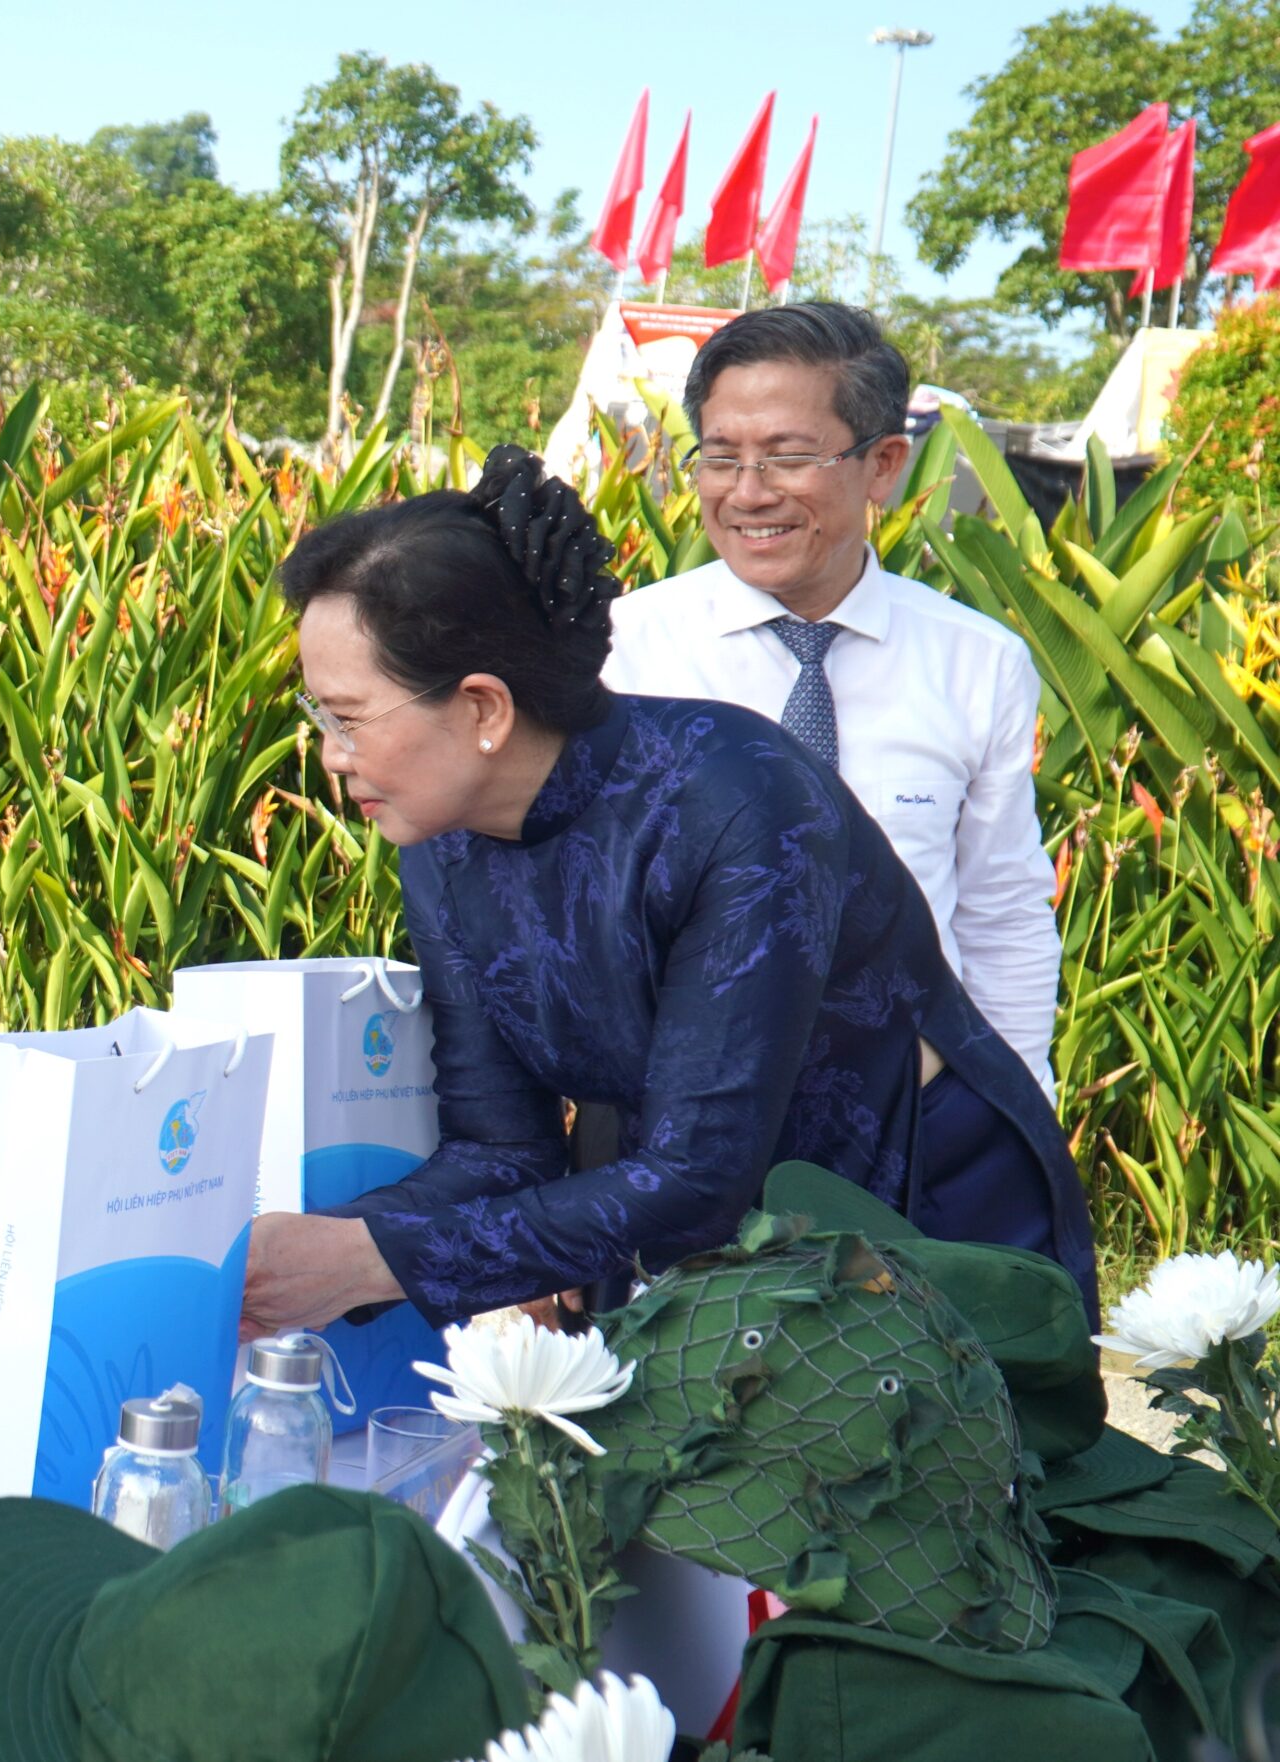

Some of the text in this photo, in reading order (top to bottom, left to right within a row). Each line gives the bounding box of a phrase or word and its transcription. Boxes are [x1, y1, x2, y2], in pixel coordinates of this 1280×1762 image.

[107, 1197, 123, 1214] HỘI
[124, 1193, 145, 1211] LIÊN
[167, 1187, 184, 1203] PHỤ
[208, 1175, 224, 1190] NAM
[4, 1223, 16, 1247] HỘI
